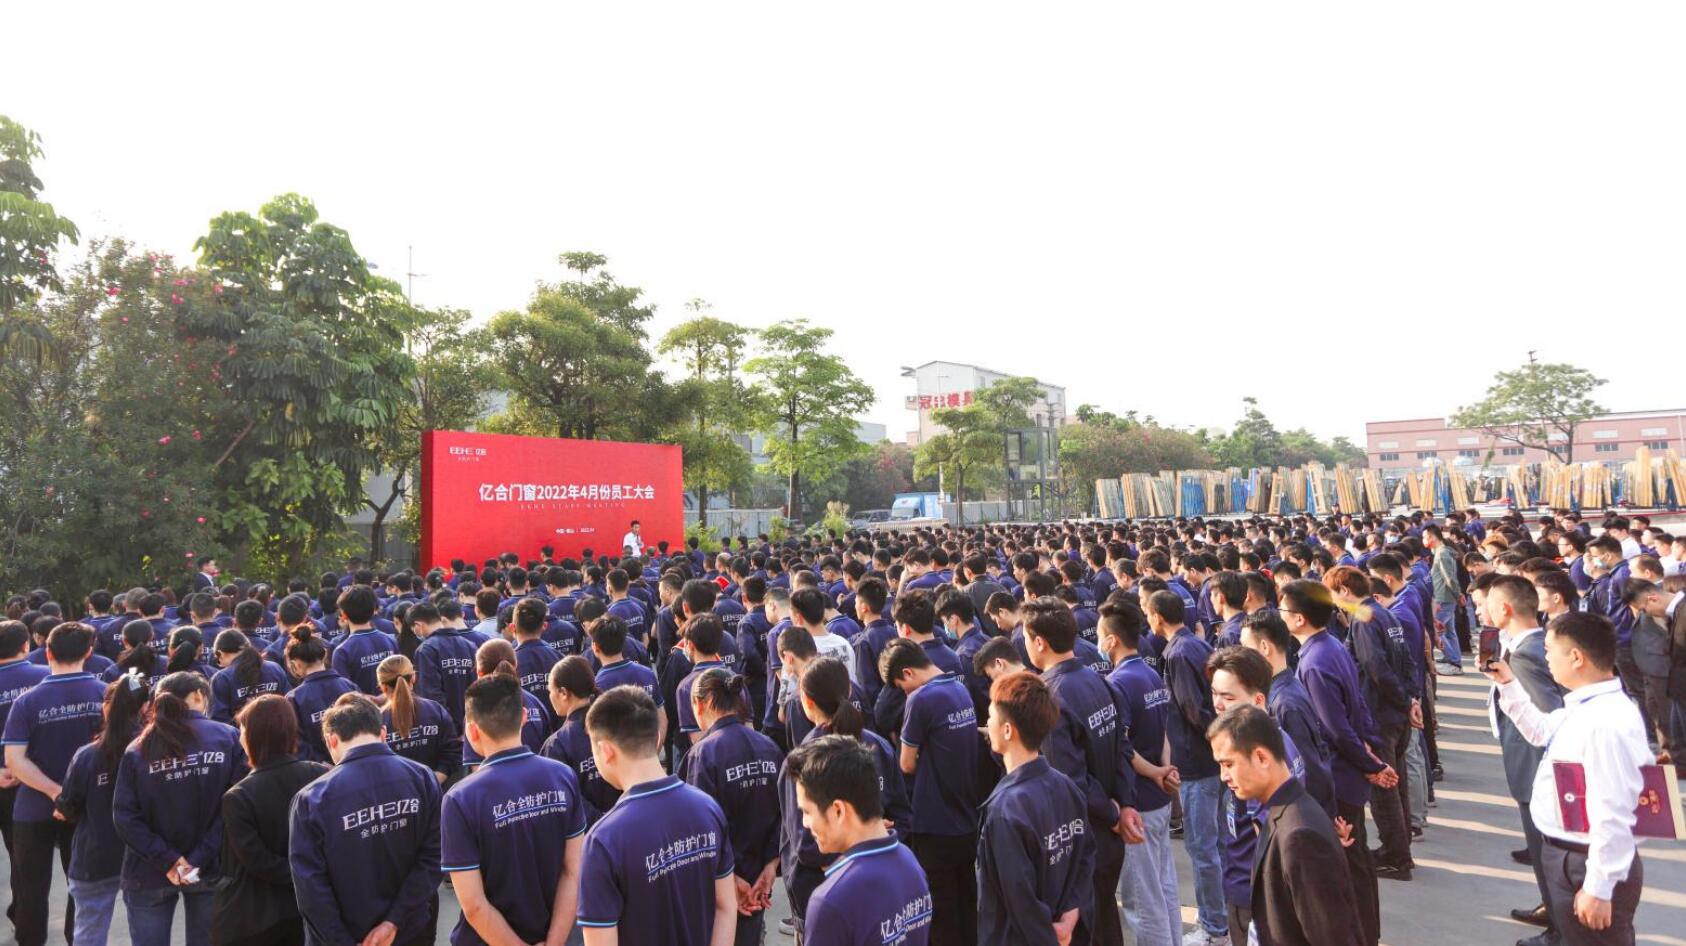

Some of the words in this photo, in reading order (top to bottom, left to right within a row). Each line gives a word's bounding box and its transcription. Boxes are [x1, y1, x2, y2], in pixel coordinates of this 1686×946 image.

[479, 483, 655, 501] 亿合门窗2022年4月份员工大会
[342, 803, 398, 831] EEHE
[396, 799, 420, 819] 亿合
[361, 819, 408, 839] 全防护门窗
